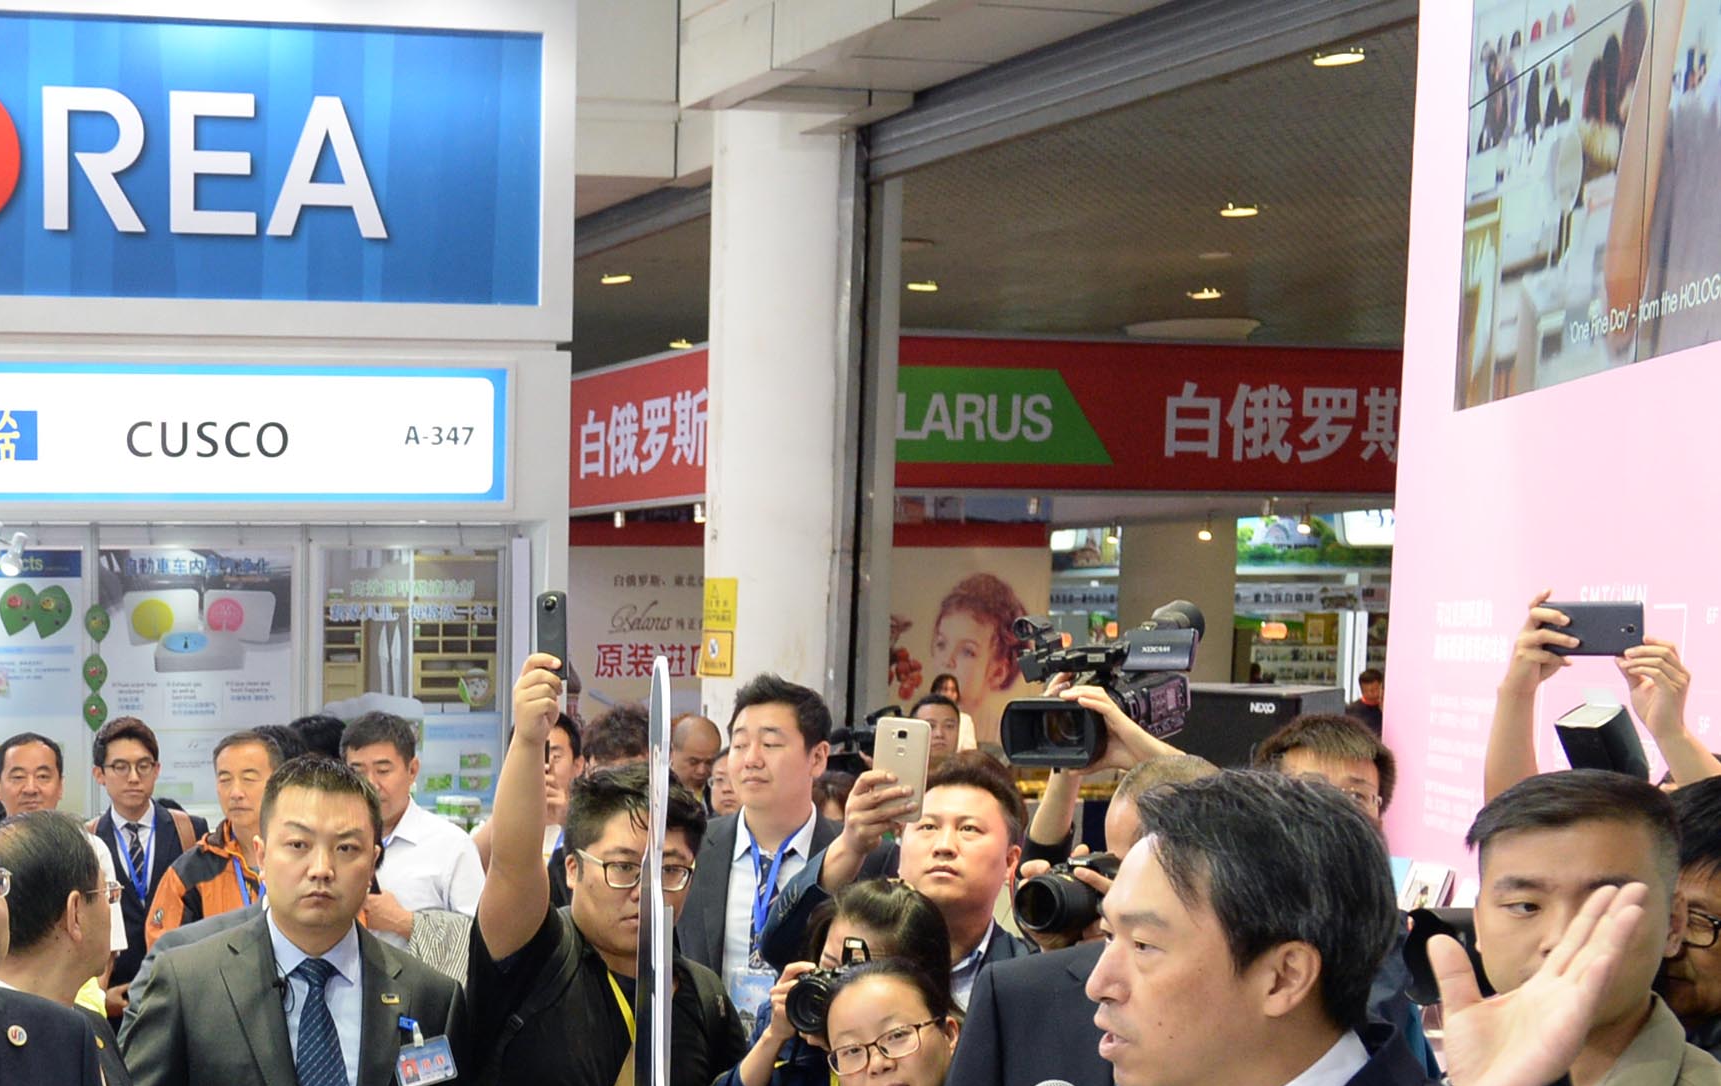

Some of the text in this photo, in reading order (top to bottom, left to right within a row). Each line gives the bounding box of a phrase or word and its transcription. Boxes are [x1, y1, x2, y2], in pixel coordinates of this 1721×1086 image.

[1661, 291, 1678, 315] the
[126, 420, 290, 458] CUSCO
[404, 425, 475, 446] A-347
[579, 390, 709, 479] 白俄罗斯
